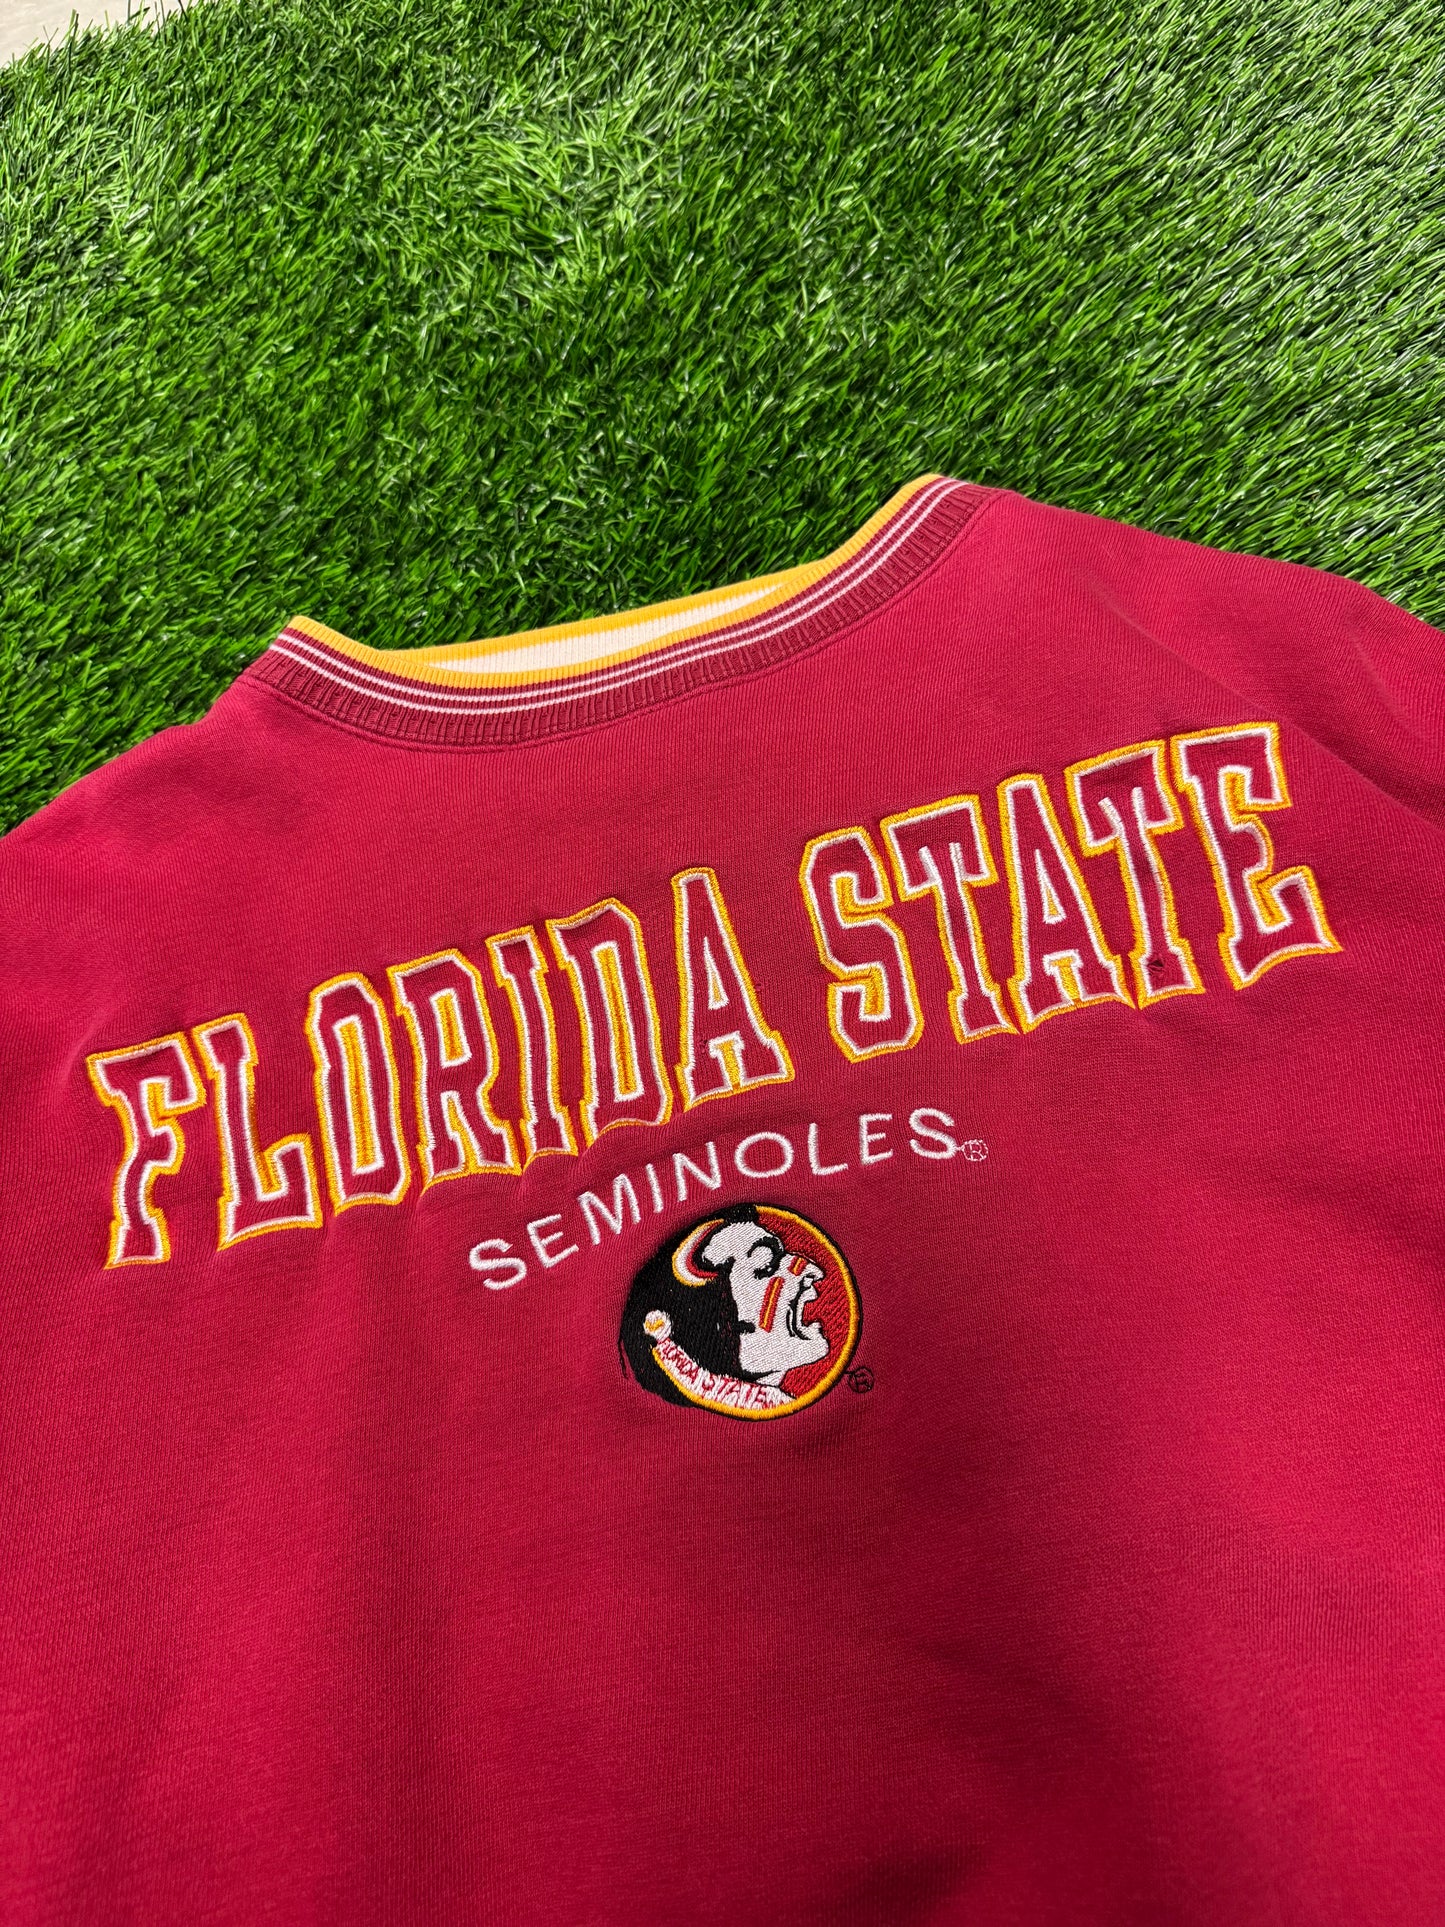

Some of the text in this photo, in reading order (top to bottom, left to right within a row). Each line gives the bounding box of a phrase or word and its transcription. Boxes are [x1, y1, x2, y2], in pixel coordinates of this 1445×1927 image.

[87, 722, 1342, 1268] FLORIDA STATE
[656, 1337, 774, 1409] FLORIDA STATE
